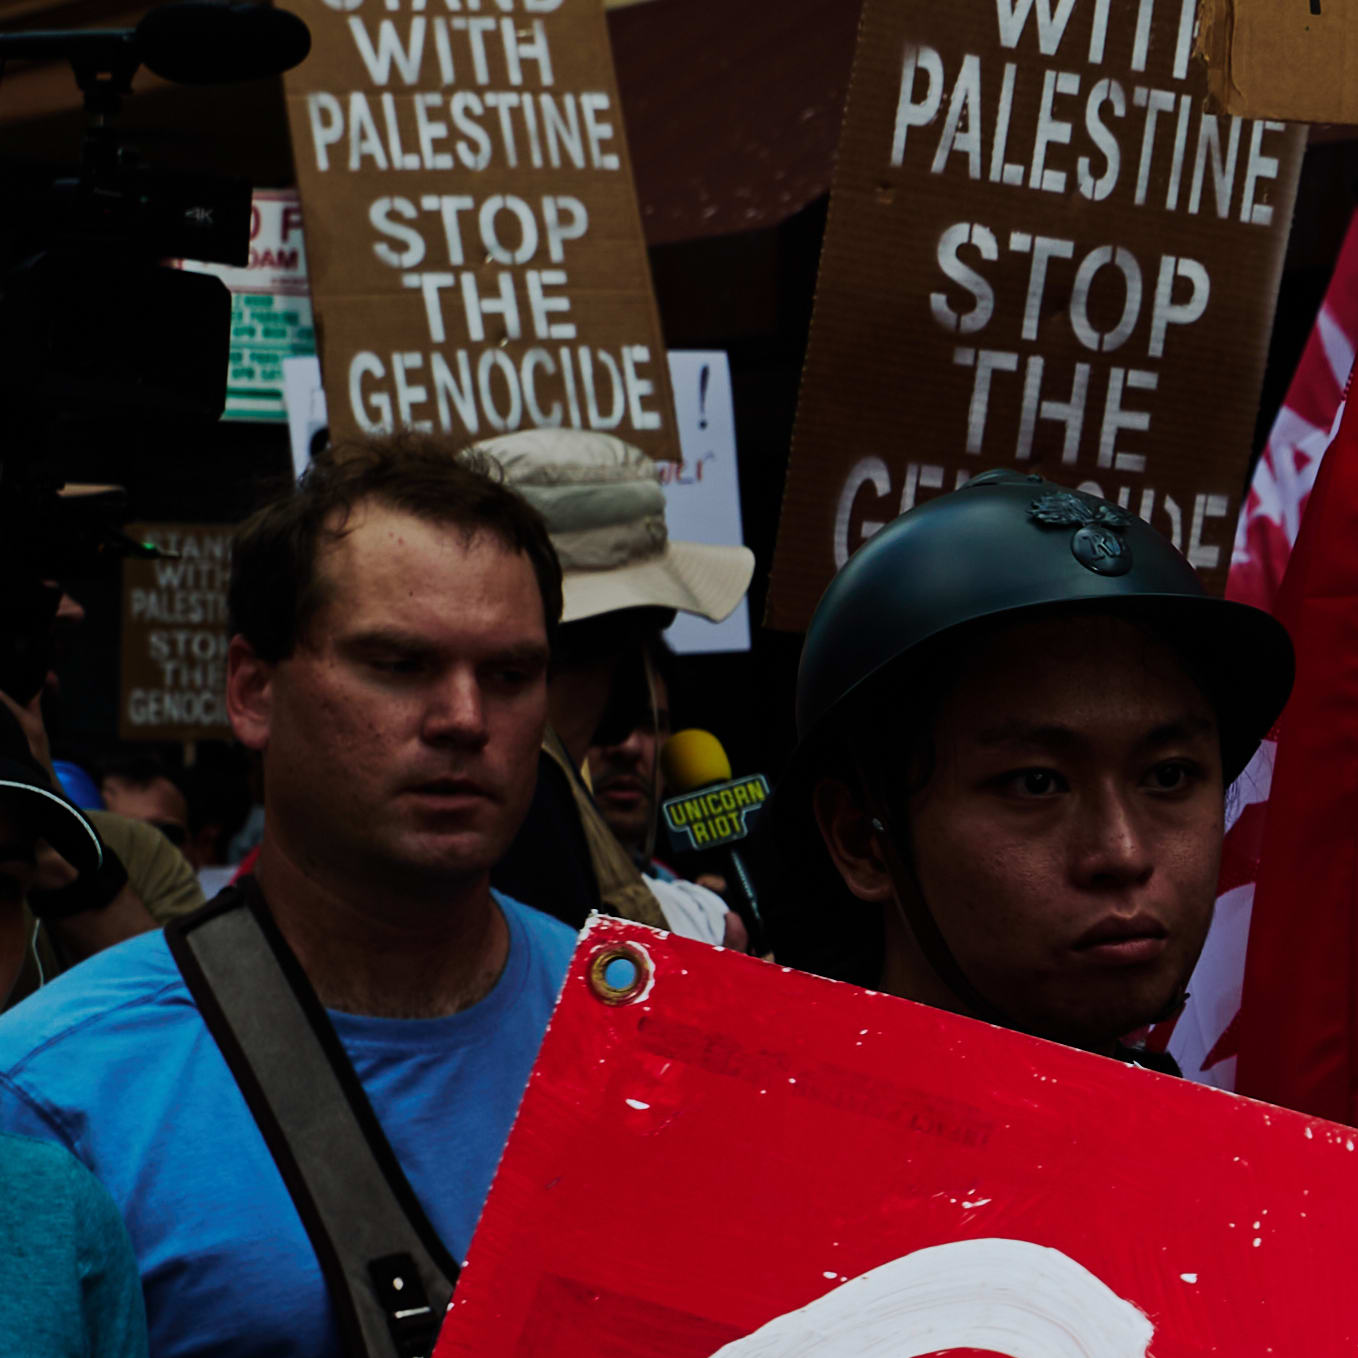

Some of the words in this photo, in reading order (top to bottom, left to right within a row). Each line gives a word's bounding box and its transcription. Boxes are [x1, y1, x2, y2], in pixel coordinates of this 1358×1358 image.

[348, 16, 554, 86] WITH
[307, 92, 620, 171] PALESTINE
[890, 43, 1286, 226] PALESTINE
[368, 194, 589, 268] STOP
[402, 270, 577, 343] THE
[929, 221, 1212, 359] STOP
[349, 346, 662, 434] GENOCIDE
[952, 346, 1160, 473] THE
[670, 781, 764, 825] UNICORN
[692, 811, 741, 844] RIOT
